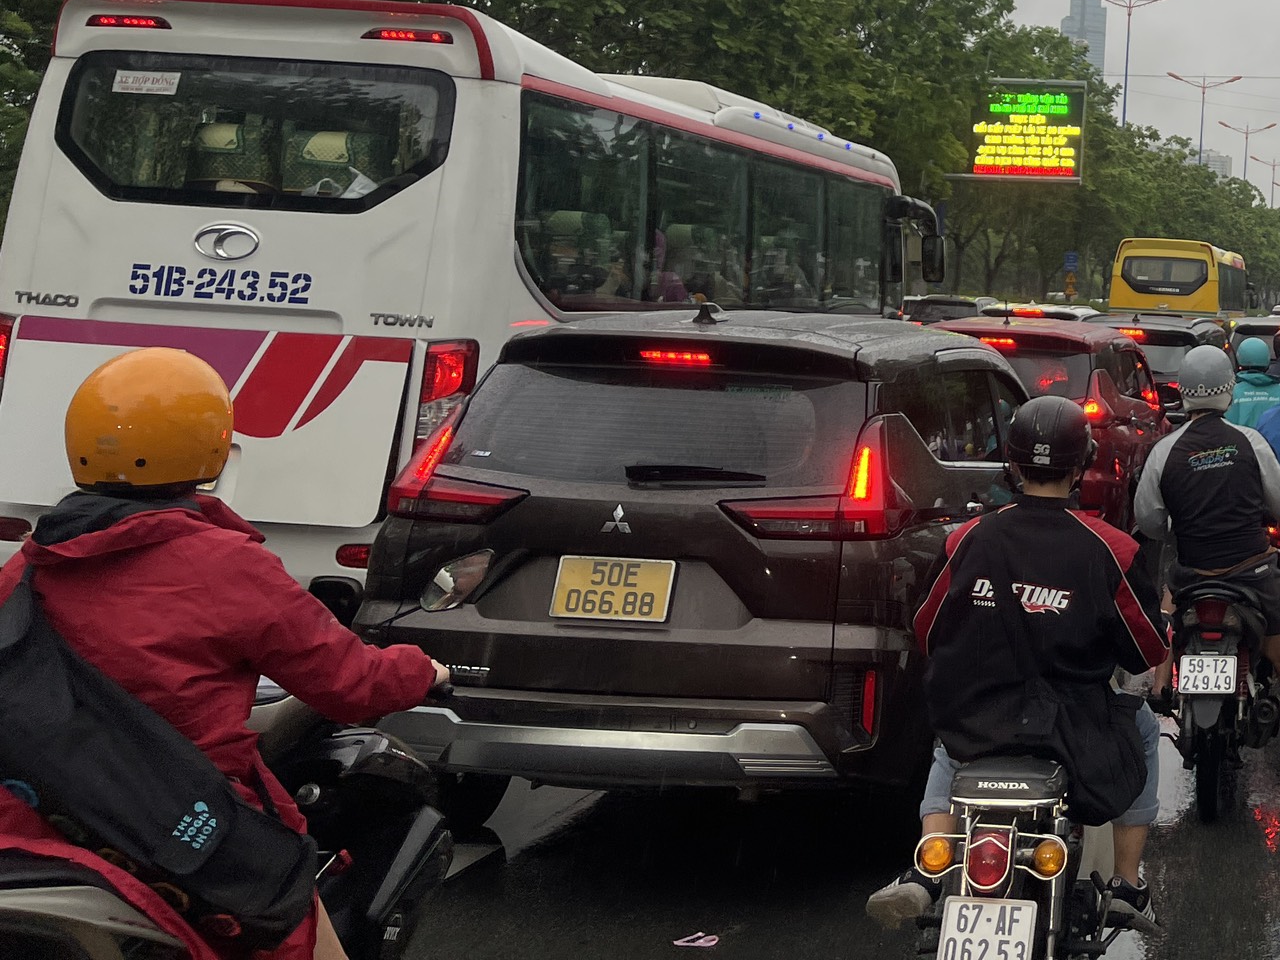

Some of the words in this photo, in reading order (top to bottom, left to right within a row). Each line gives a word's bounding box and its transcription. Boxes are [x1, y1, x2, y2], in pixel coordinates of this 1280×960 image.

[118, 76, 131, 84] XE
[129, 263, 313, 305] 51B-243.52
[15, 290, 79, 308] THACO
[370, 312, 436, 329] TOWN
[1033, 443, 1051, 455] 5G
[590, 561, 641, 588] 50E
[565, 588, 655, 616] 066.88
[1188, 658, 1228, 674] 59-T2
[1182, 675, 1232, 691] 249.49
[977, 781, 1030, 790] HONDA
[172, 815, 193, 836] THE
[192, 818, 217, 849] SHOP
[956, 903, 1022, 936] 67-AF
[945, 937, 1026, 960] 06253
